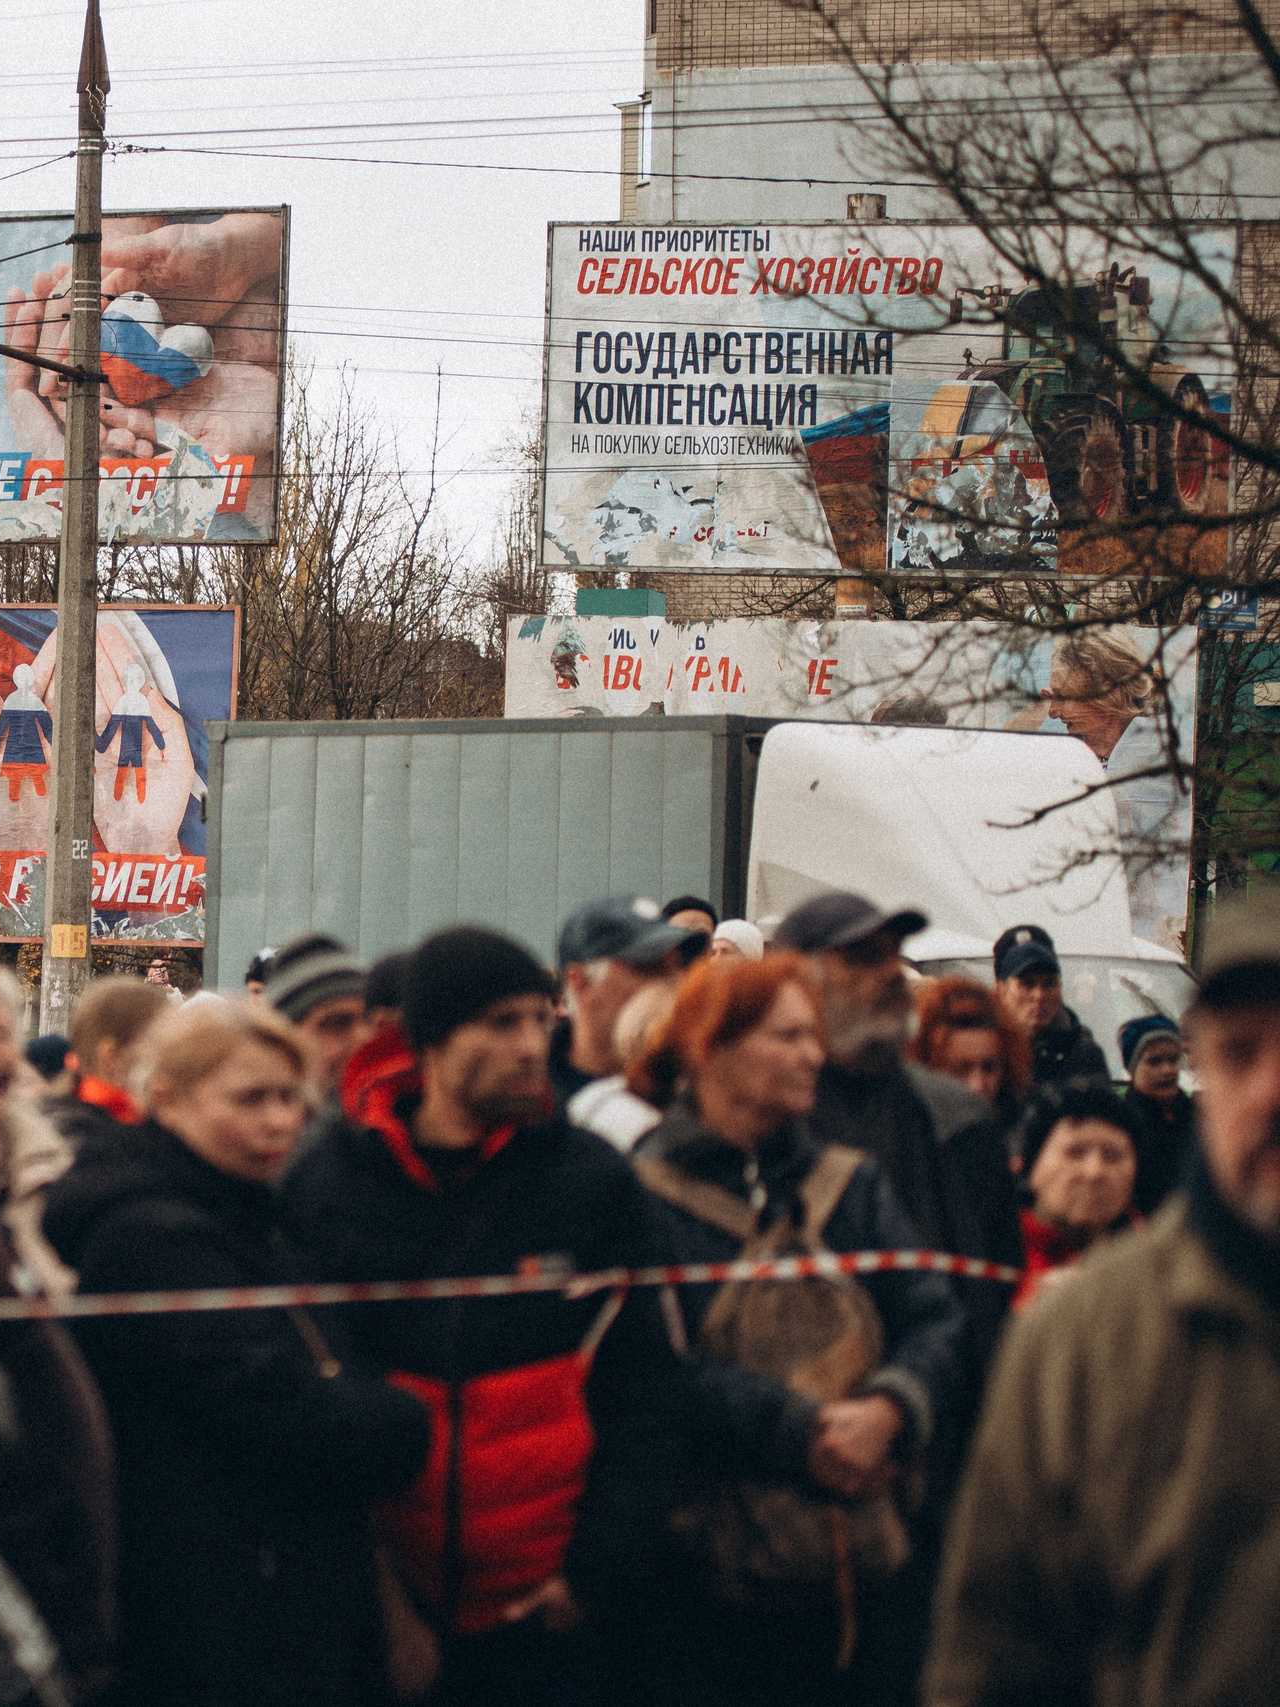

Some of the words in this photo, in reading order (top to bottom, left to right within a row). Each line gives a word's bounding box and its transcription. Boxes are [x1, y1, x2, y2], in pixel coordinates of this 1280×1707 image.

[578, 229, 636, 252] НАШИ
[641, 229, 770, 251] ПРИОРИТЕТЫ
[576, 257, 745, 295] СЕЛЬСКОЕ
[750, 247, 945, 296] ХОЗЯЙСТВО
[574, 331, 894, 380] ГОСУДАРСТВЕННАЯ
[572, 382, 818, 431] КОМПЕНСАЦИЯ
[571, 434, 590, 454] НА
[594, 434, 660, 455] ПОКУПКУ
[664, 435, 796, 456] СЕЛЬХОЗТЕХНИКИ
[72, 839, 89, 860] 22
[8, 853, 195, 906] РСИЕЙ!
